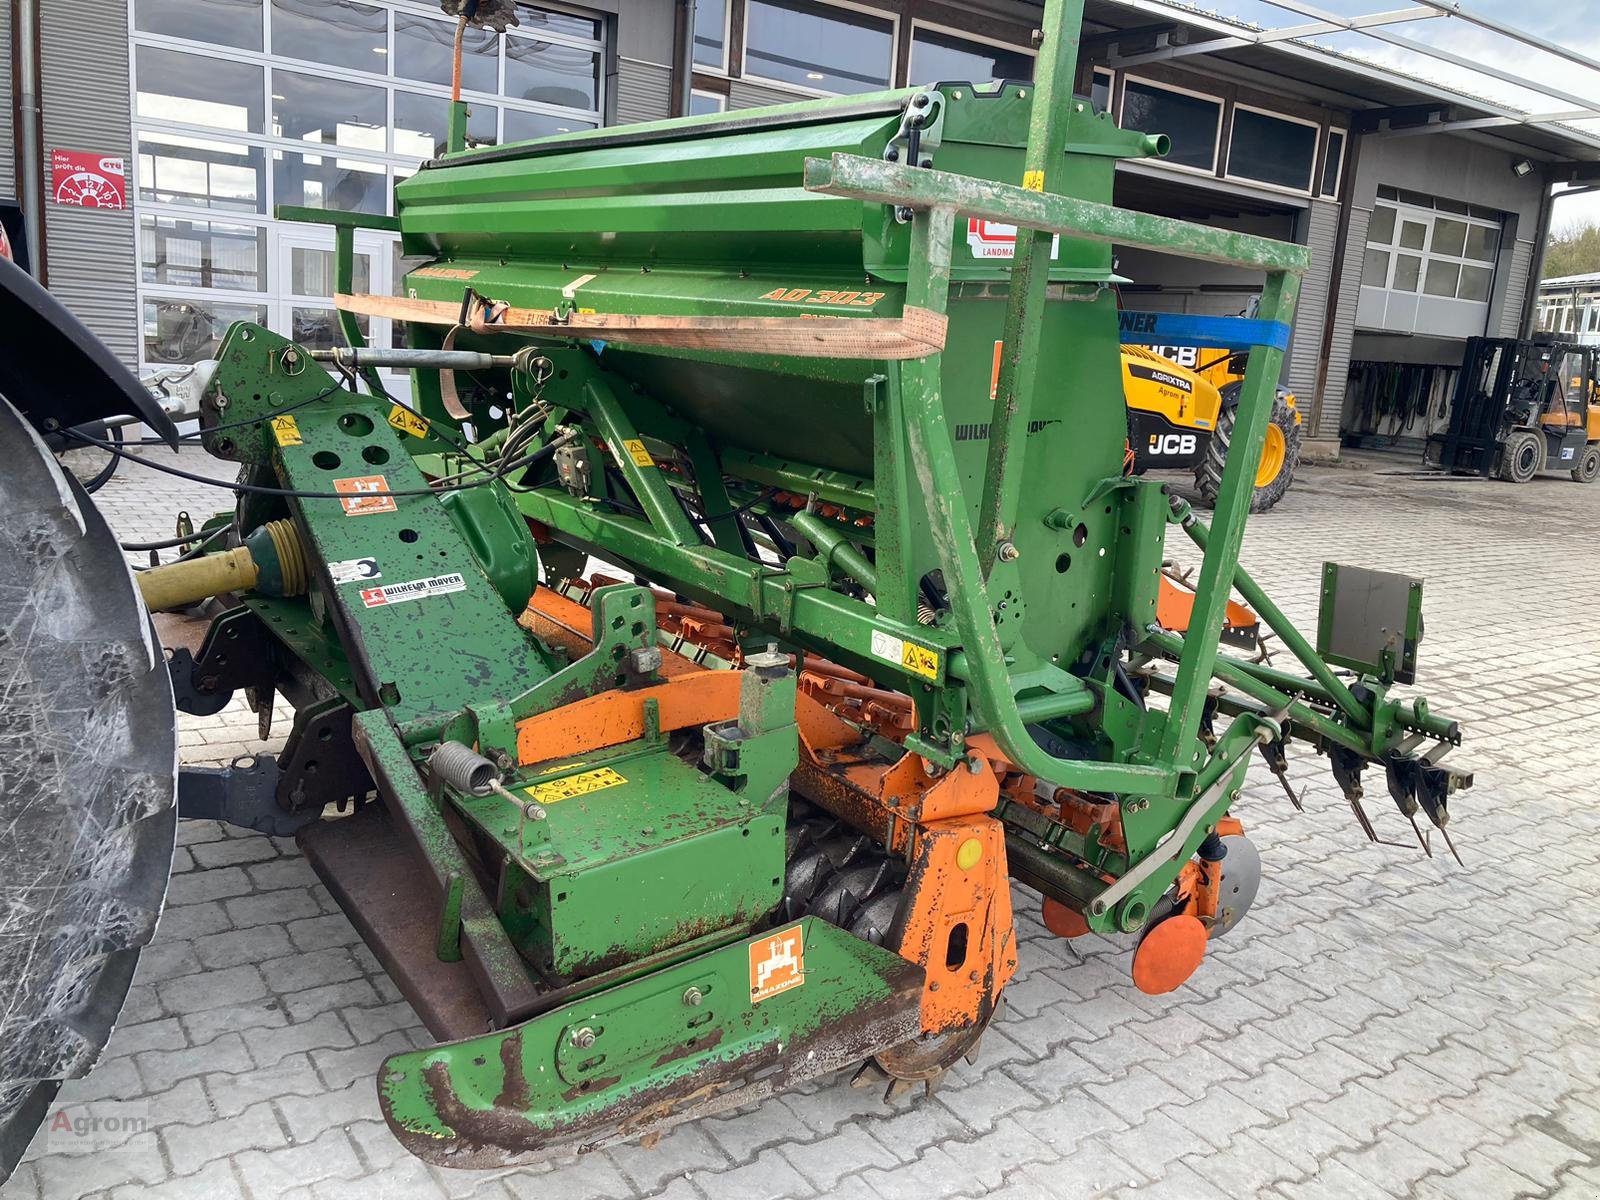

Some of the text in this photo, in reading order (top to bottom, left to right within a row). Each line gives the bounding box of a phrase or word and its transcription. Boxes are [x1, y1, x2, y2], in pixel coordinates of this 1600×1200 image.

[55, 163, 74, 171] prüft
[85, 180, 94, 188] 12
[102, 191, 112, 201] 10
[982, 247, 1014, 257] LANDMA
[758, 287, 885, 306] AD 303
[1119, 311, 1158, 334] NER
[1151, 371, 1191, 391] AGRIXTRA
[1148, 434, 1197, 455] JCB
[384, 581, 427, 596] WILHELM
[428, 575, 461, 588] MAYER
